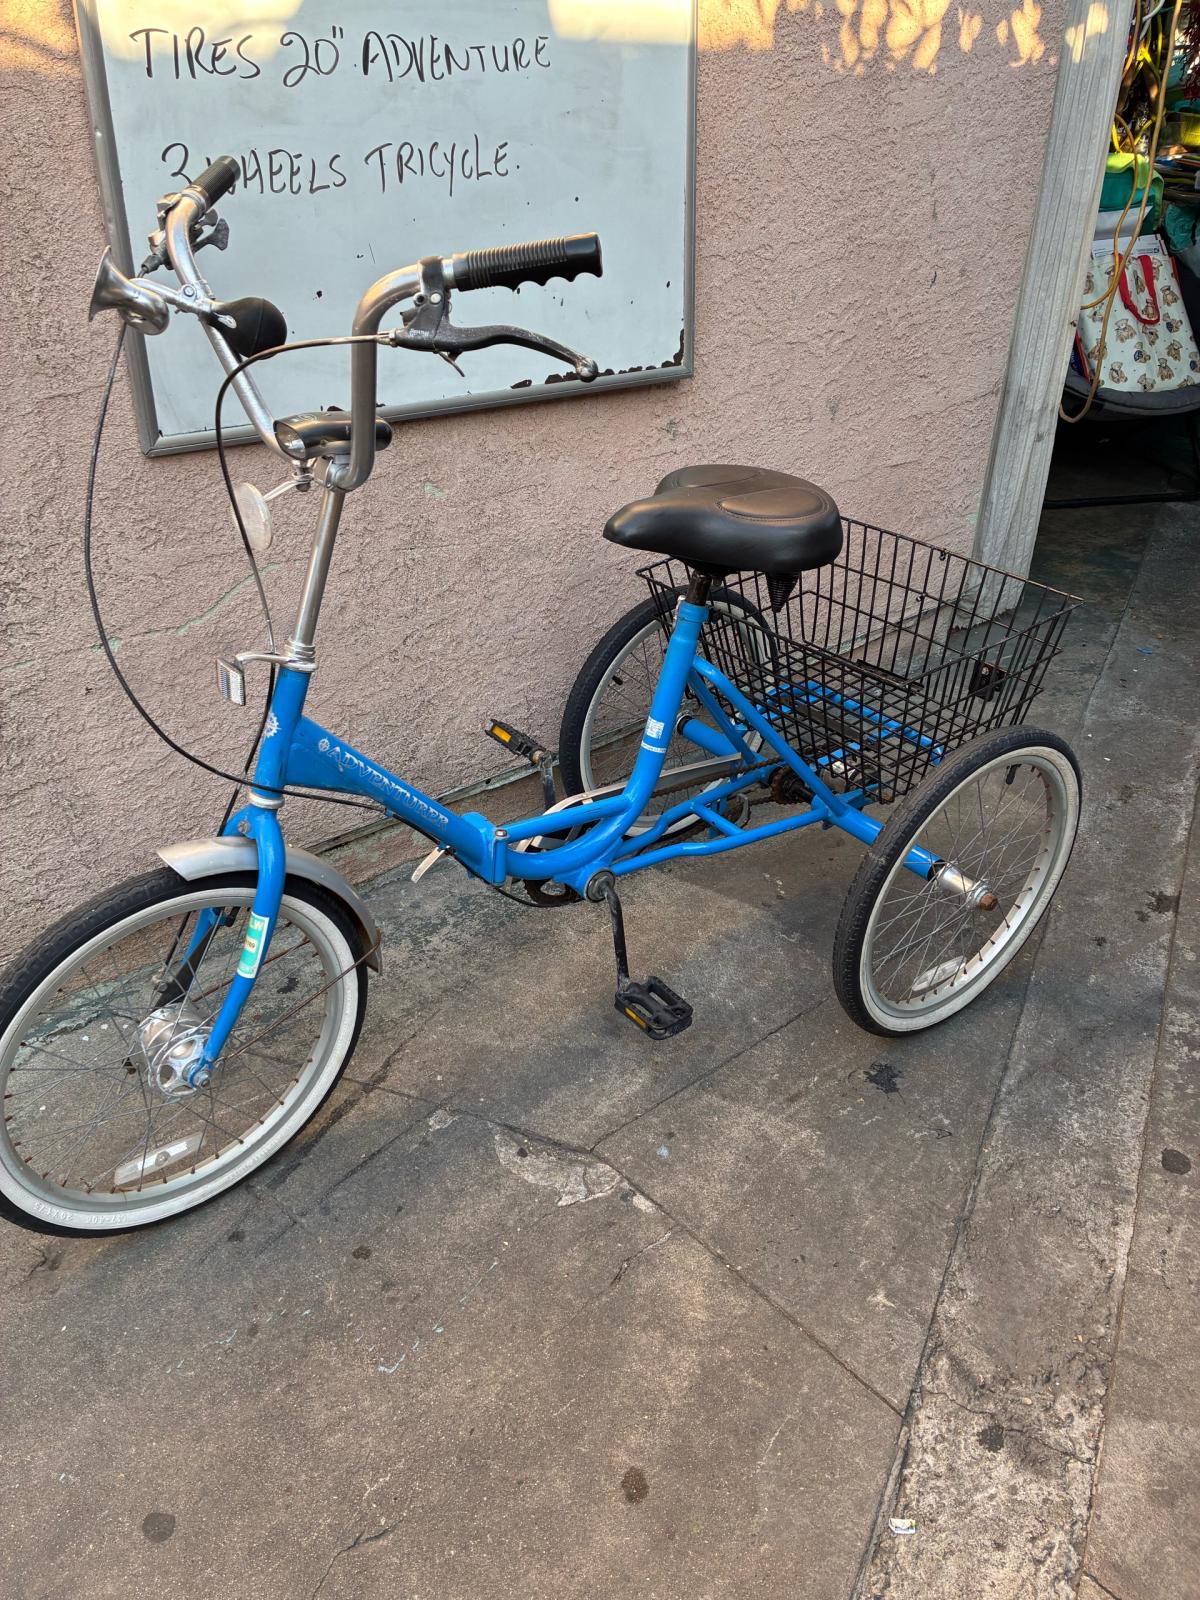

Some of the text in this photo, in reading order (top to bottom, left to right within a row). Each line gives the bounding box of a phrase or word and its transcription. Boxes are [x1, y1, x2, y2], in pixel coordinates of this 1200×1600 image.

[130, 26, 551, 87] TIRES 20" ADVENTURE
